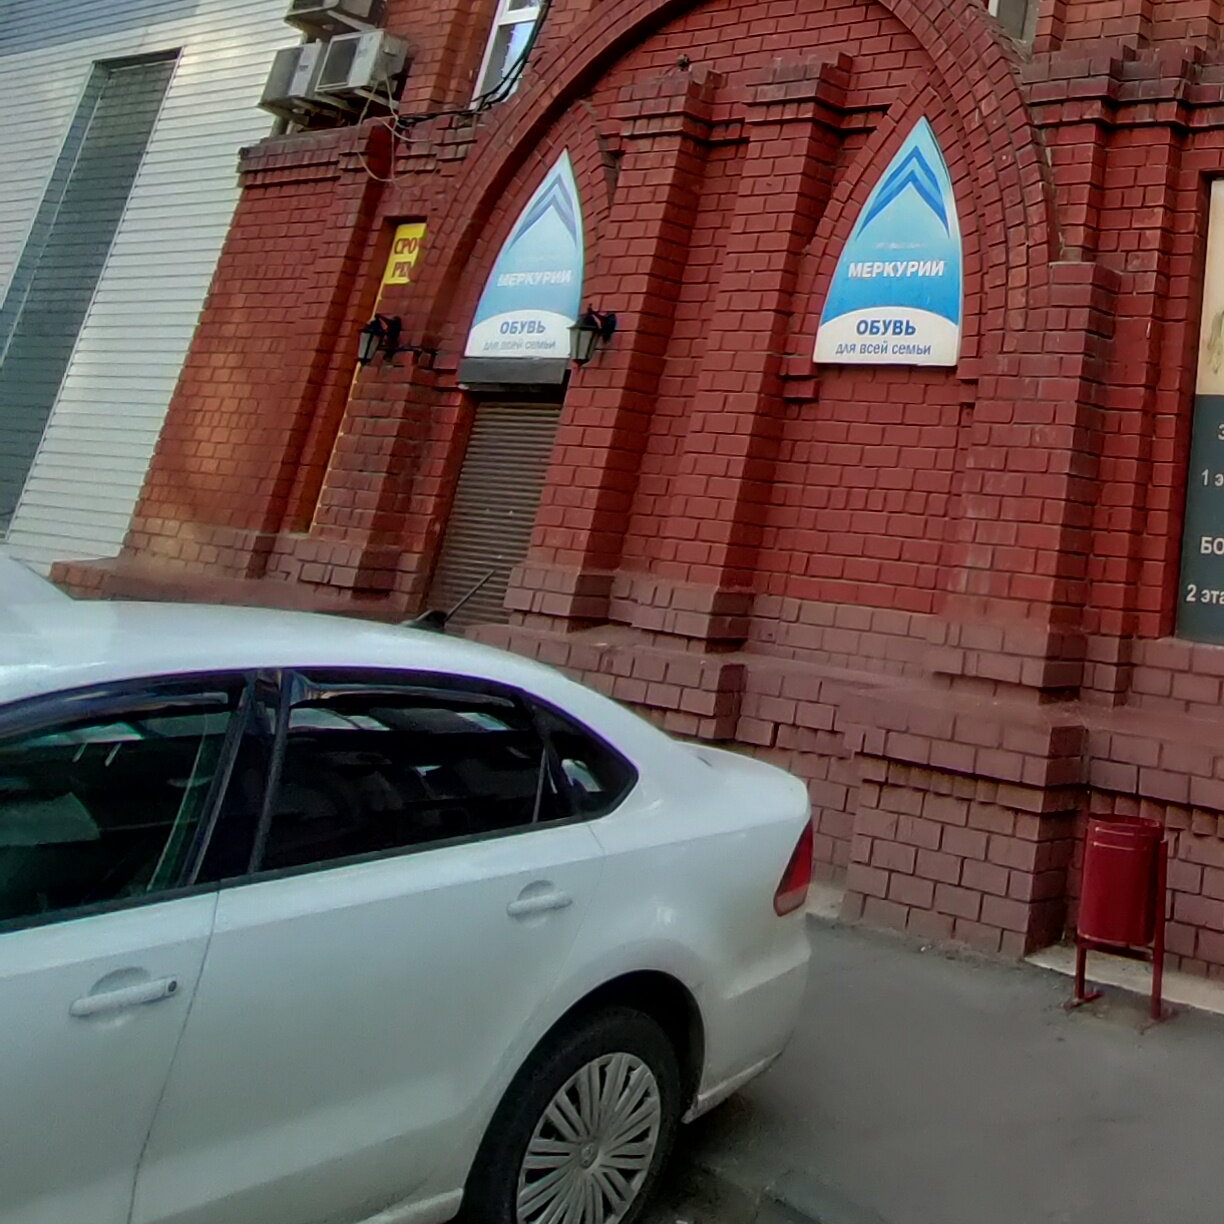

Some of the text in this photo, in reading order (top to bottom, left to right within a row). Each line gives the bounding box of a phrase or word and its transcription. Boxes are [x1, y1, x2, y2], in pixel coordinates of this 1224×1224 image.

[500, 320, 546, 334] ОБУВЬ
[856, 319, 916, 335] ОБУВЬ
[859, 340, 888, 355] всей
[892, 344, 931, 355] семьи
[1201, 469, 1209, 485] 1
[1185, 584, 1197, 602] 2
